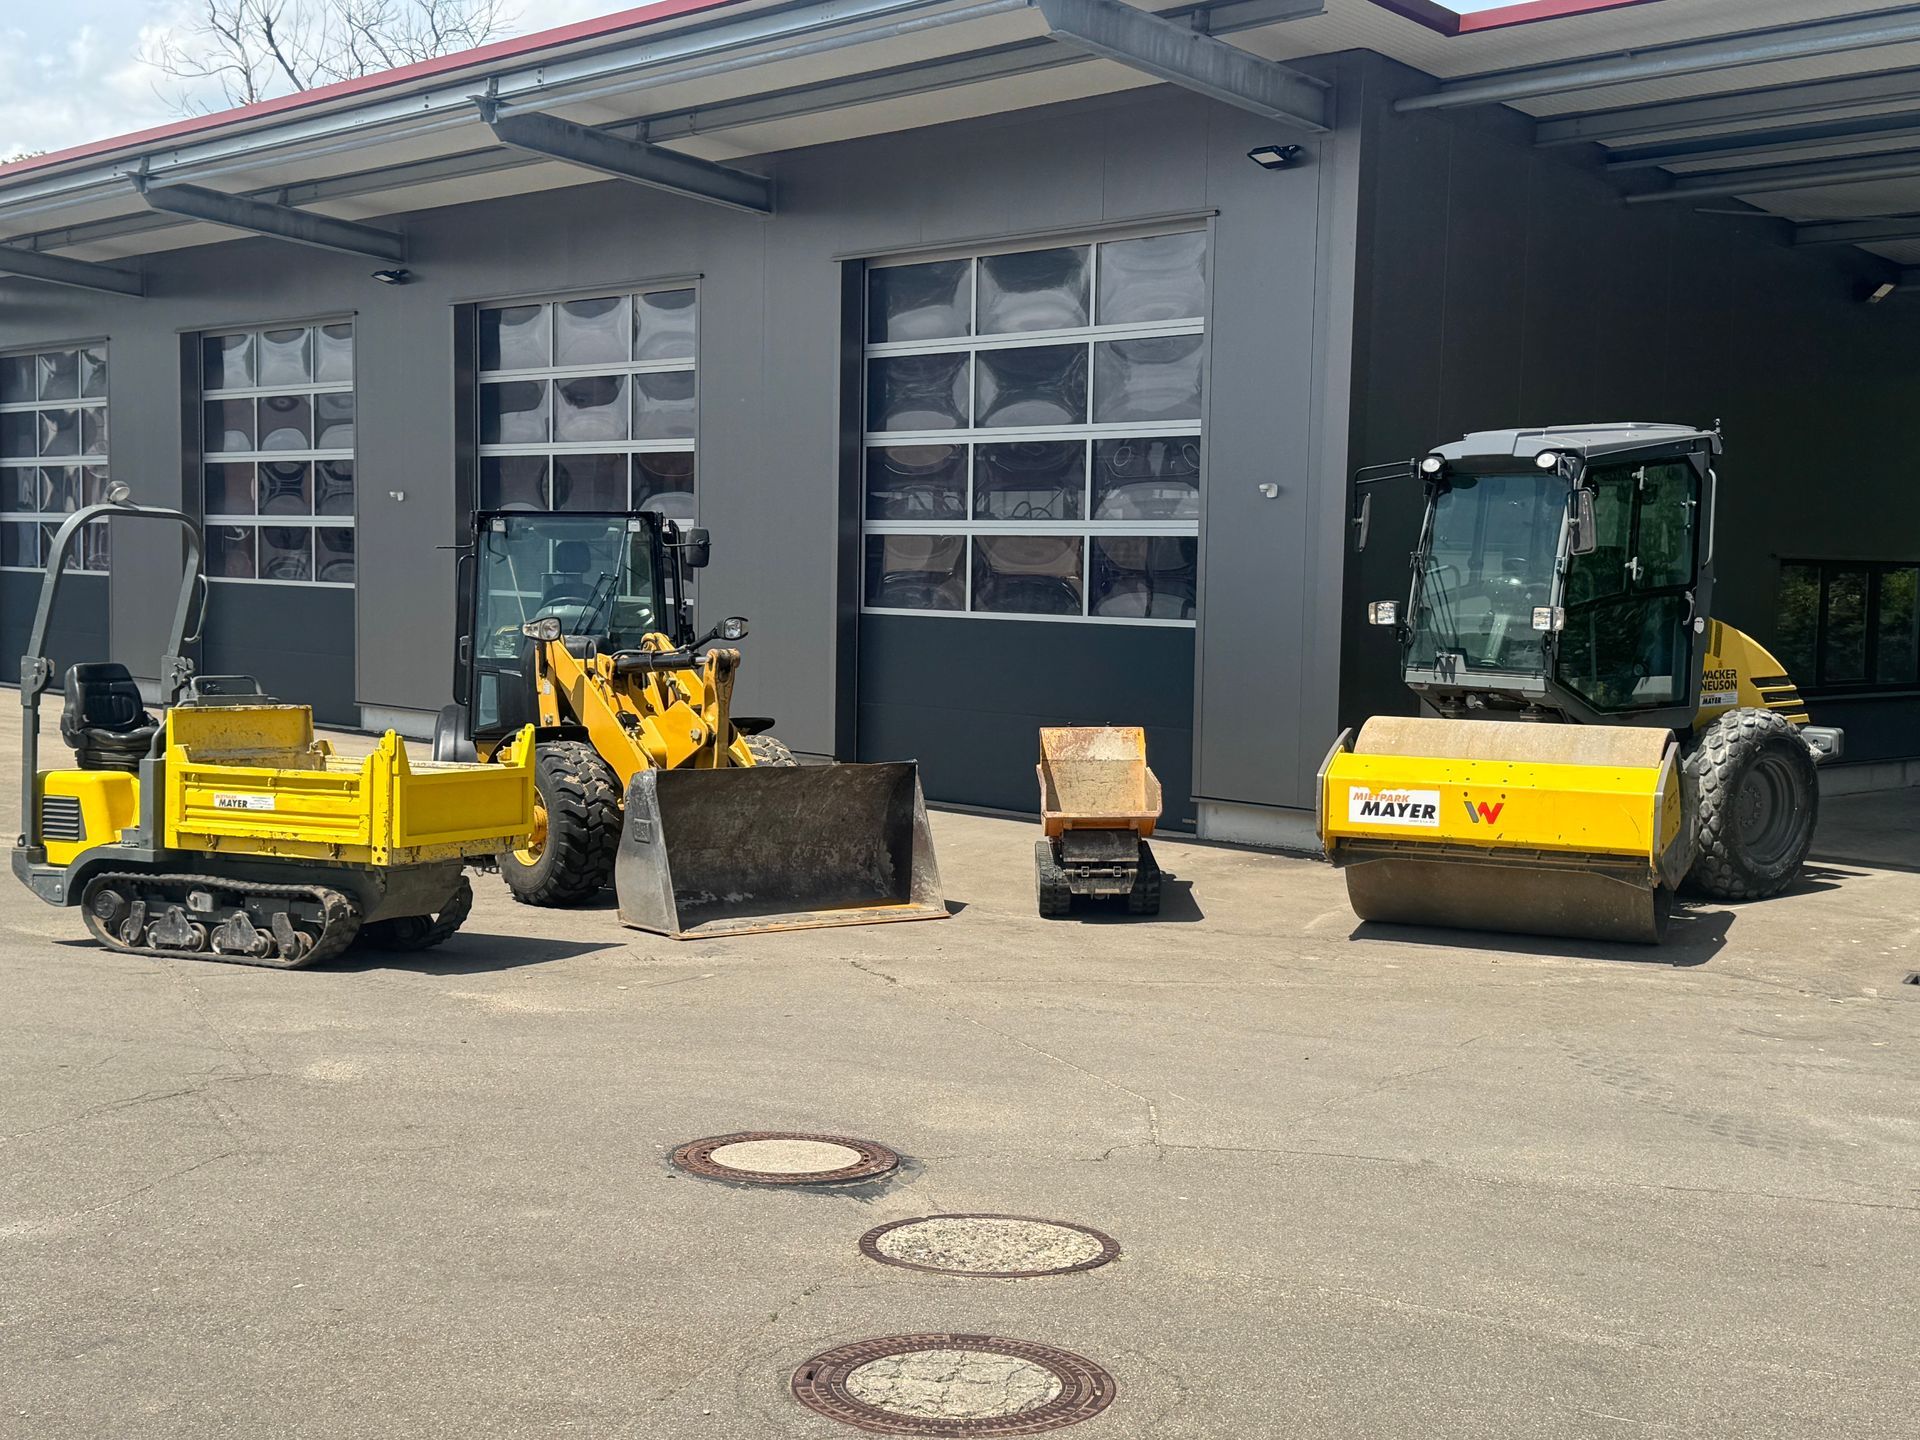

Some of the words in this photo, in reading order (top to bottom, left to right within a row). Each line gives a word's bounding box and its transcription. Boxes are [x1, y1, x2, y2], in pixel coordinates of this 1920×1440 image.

[1701, 680, 1737, 691] NEUSON
[1702, 696, 1722, 705] MAYER
[1353, 792, 1410, 802] MIETPARK
[218, 799, 248, 808] MAYER
[1360, 801, 1436, 819] MAYER
